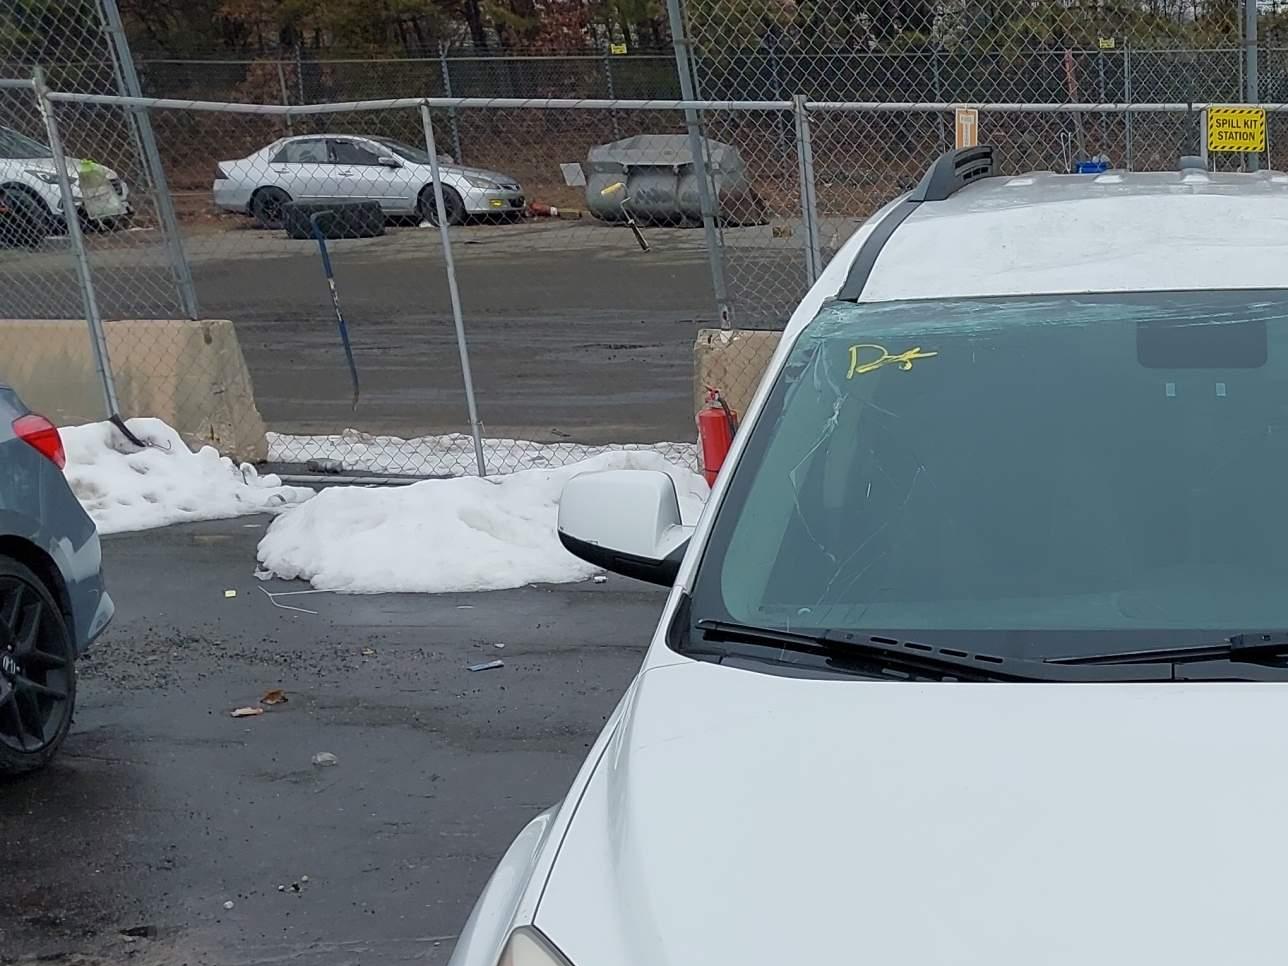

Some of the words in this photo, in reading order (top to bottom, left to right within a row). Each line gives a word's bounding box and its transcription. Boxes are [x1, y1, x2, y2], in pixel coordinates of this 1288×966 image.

[1215, 118, 1241, 129] SPILL
[1243, 119, 1258, 129] KIT
[1217, 131, 1255, 141] STATION
